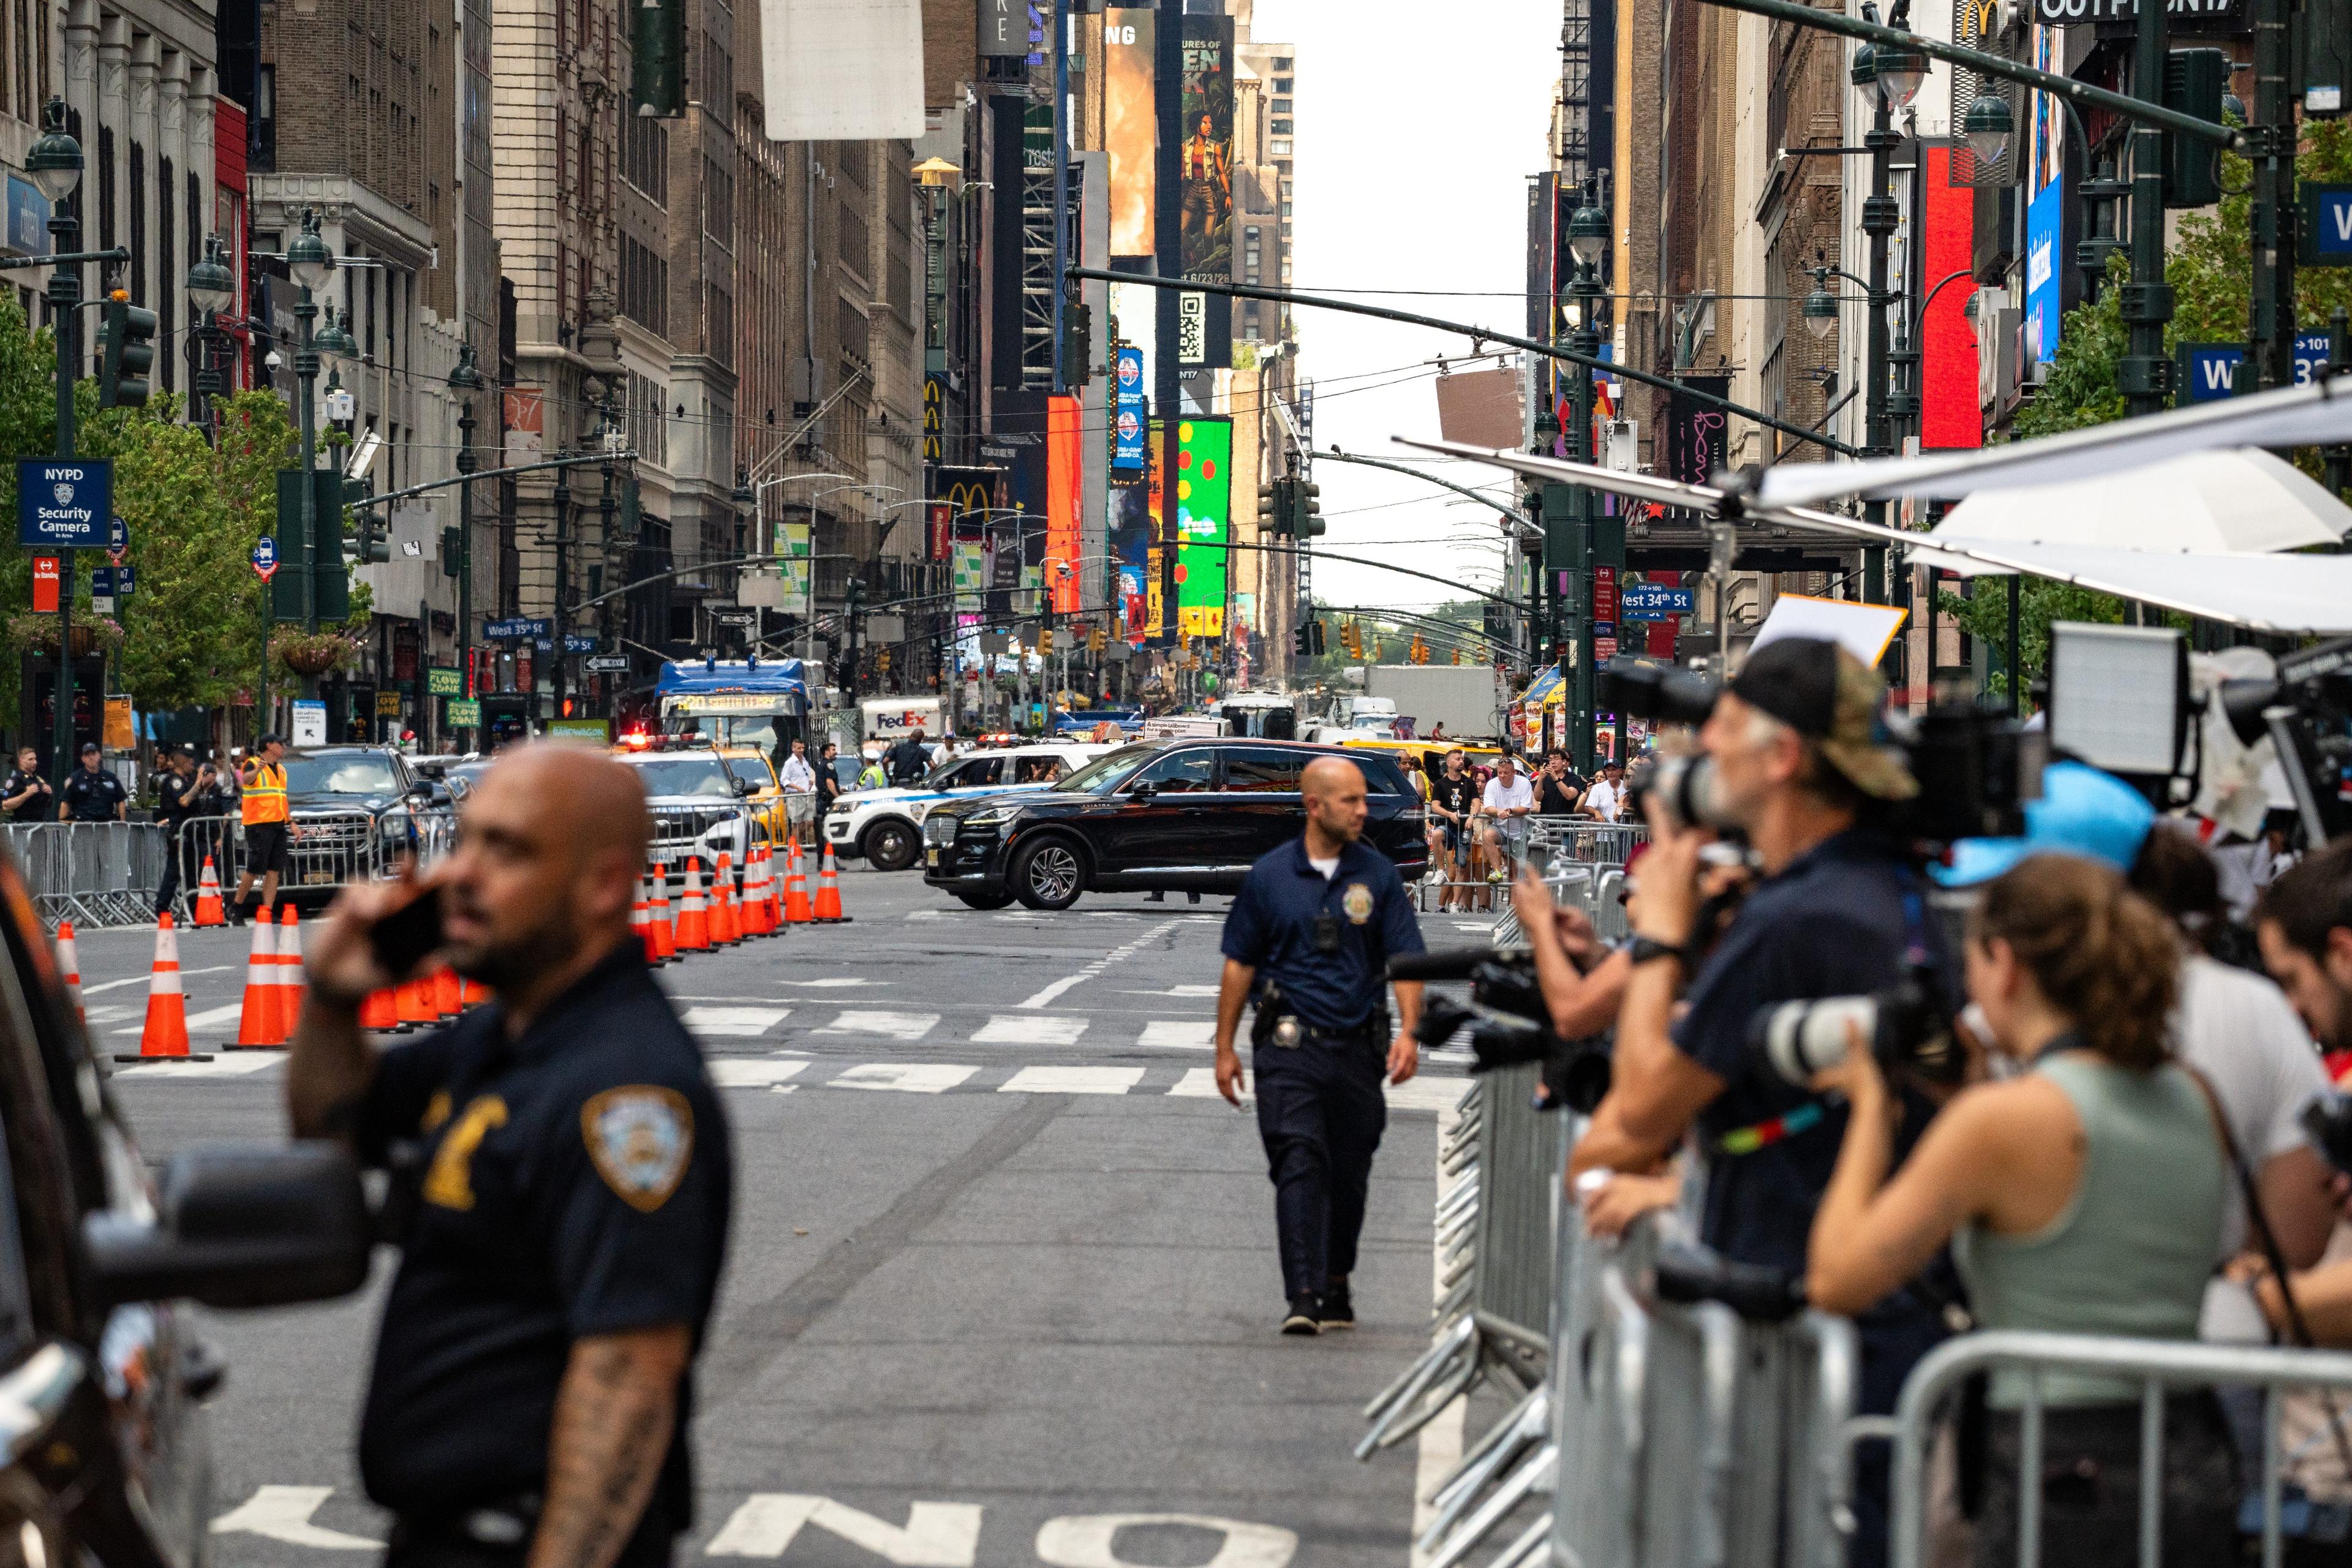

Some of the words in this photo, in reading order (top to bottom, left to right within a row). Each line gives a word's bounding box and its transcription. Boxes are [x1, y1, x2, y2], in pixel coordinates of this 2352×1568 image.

[1207, 40, 1221, 49] OF
[2307, 338, 2330, 350] 101
[45, 469, 83, 481] NYPD
[38, 507, 92, 522] Security
[39, 521, 90, 533] Camera
[41, 572, 58, 581] Standing
[1648, 593, 1670, 607] 34th
[1674, 594, 1687, 606] St
[488, 625, 512, 636] West
[514, 624, 532, 635] 35th
[533, 624, 543, 633] St
[581, 640, 592, 650] St
[430, 675, 461, 685] FLOW
[430, 684, 461, 693] ZONE
[449, 707, 478, 716] FLOW
[450, 715, 479, 725] ZONE
[876, 710, 927, 729] FedEx
